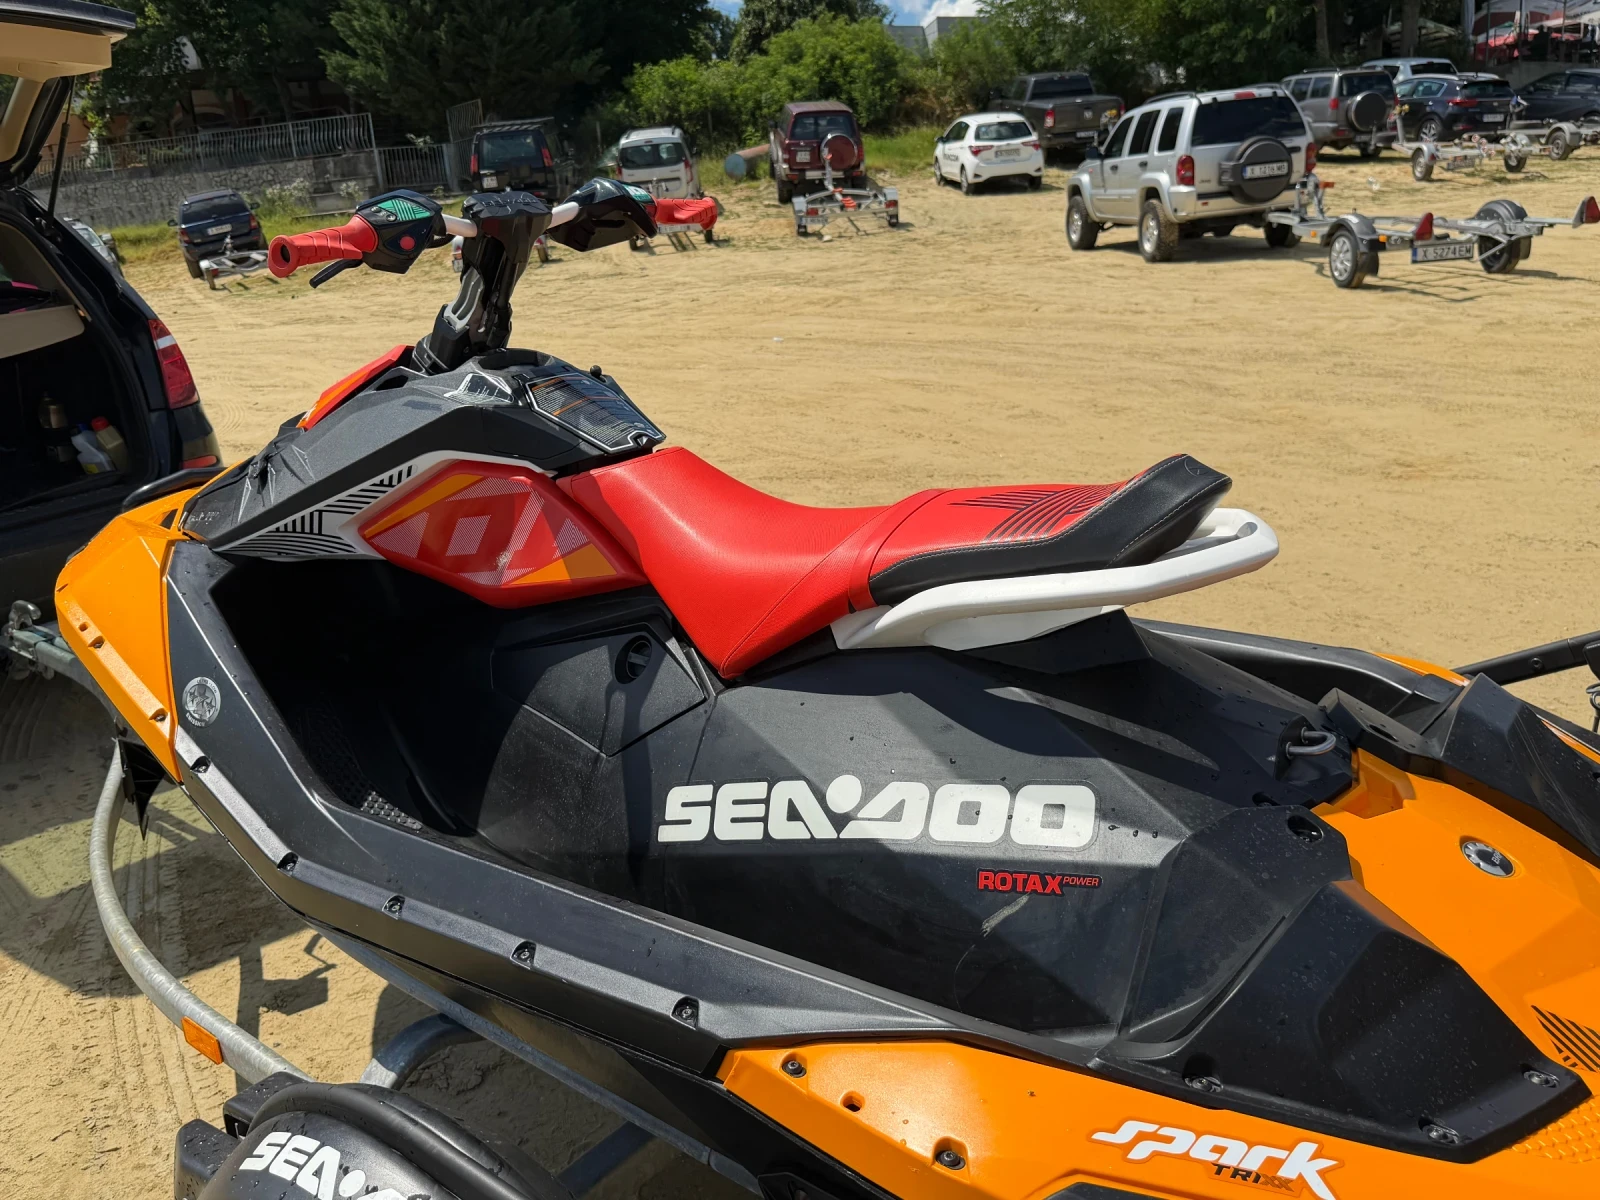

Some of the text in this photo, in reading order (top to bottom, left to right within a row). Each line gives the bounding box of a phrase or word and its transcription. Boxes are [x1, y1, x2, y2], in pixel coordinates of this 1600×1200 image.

[1433, 246, 1457, 259] 5274
[978, 871, 1100, 895] ROTAX POWER
[1211, 1162, 1295, 1193] TRIXX
